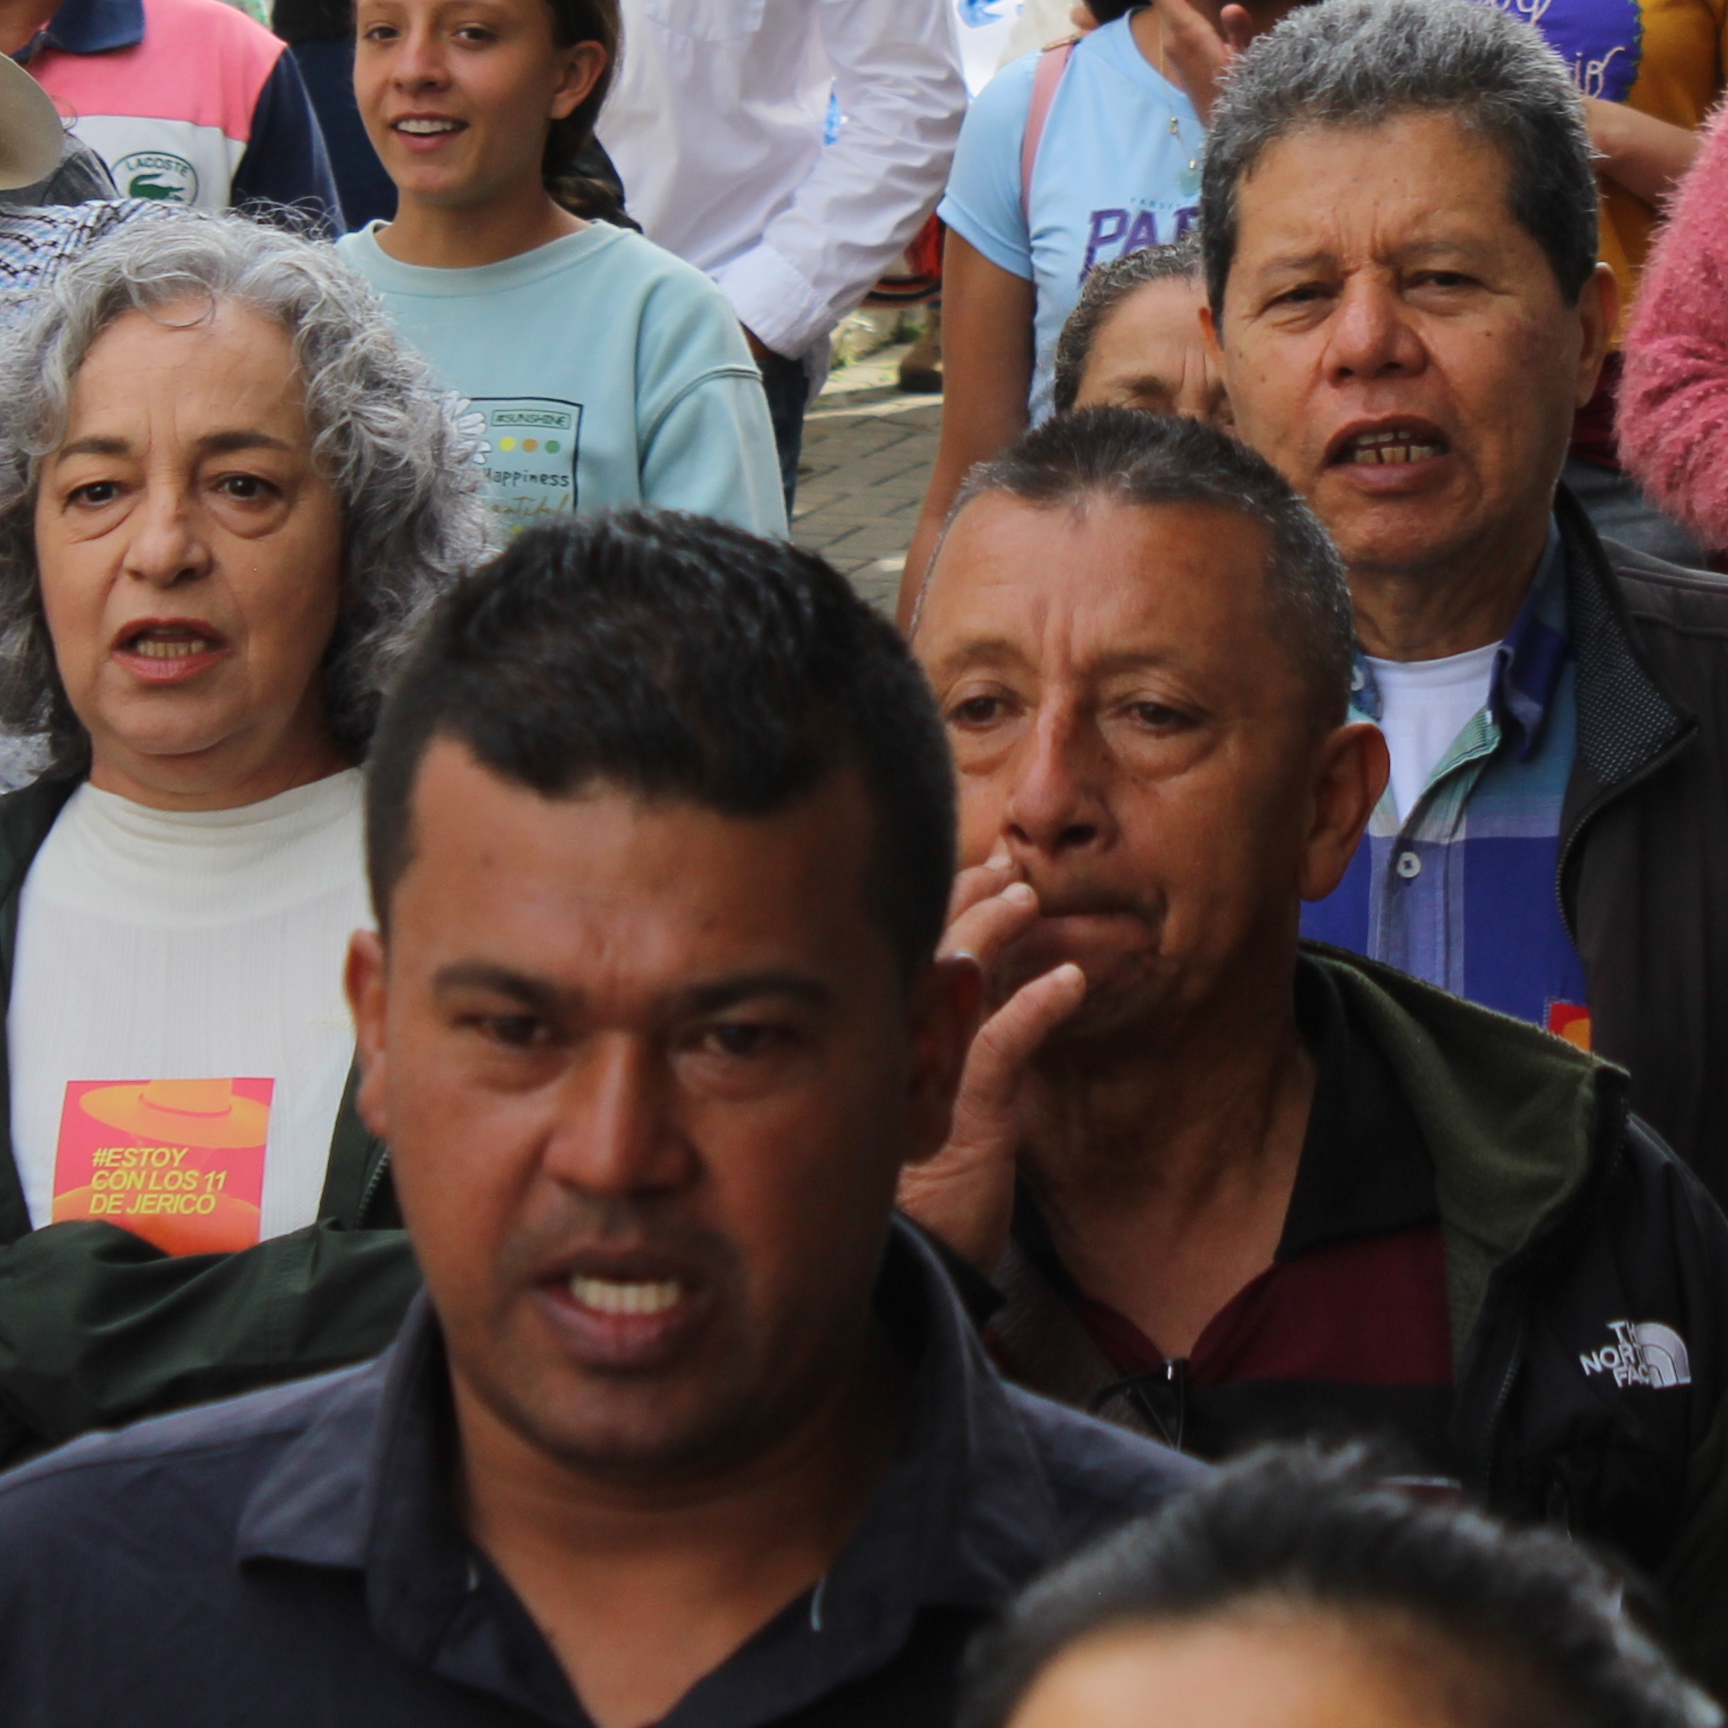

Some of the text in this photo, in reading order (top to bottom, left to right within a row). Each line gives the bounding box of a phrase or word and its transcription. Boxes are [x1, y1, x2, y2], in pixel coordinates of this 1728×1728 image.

[125, 156, 192, 177] LACOSTE
[92, 1147, 189, 1168] #ESTOY
[91, 1170, 227, 1192] CON LOS 11
[89, 1193, 123, 1214] DE
